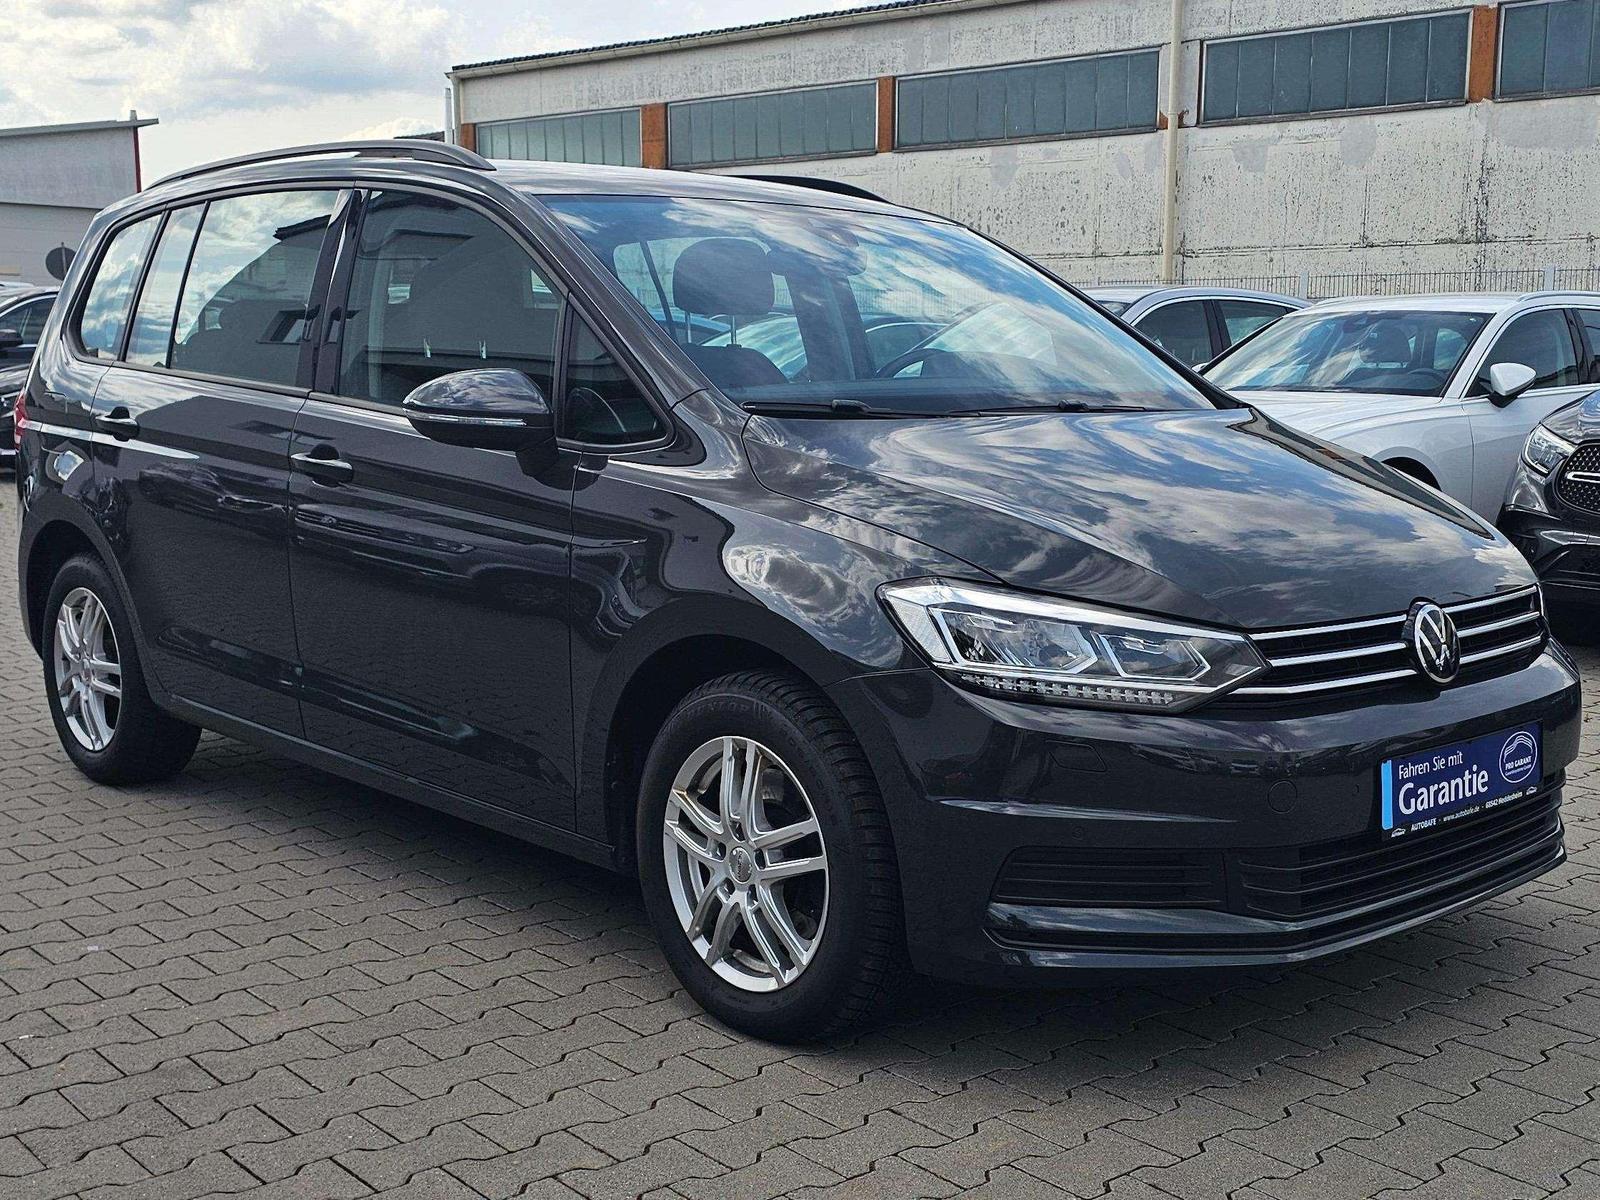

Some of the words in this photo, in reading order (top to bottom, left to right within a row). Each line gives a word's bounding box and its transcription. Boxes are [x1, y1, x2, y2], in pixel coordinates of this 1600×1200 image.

[1398, 762, 1430, 780] Fahren
[1432, 755, 1446, 771] Sie
[1448, 750, 1464, 767] mit
[1505, 760, 1515, 771] PRO
[1514, 755, 1532, 768] GARANT
[1398, 764, 1489, 815] Garantie
[1410, 817, 1437, 832] AUTOBAFE
